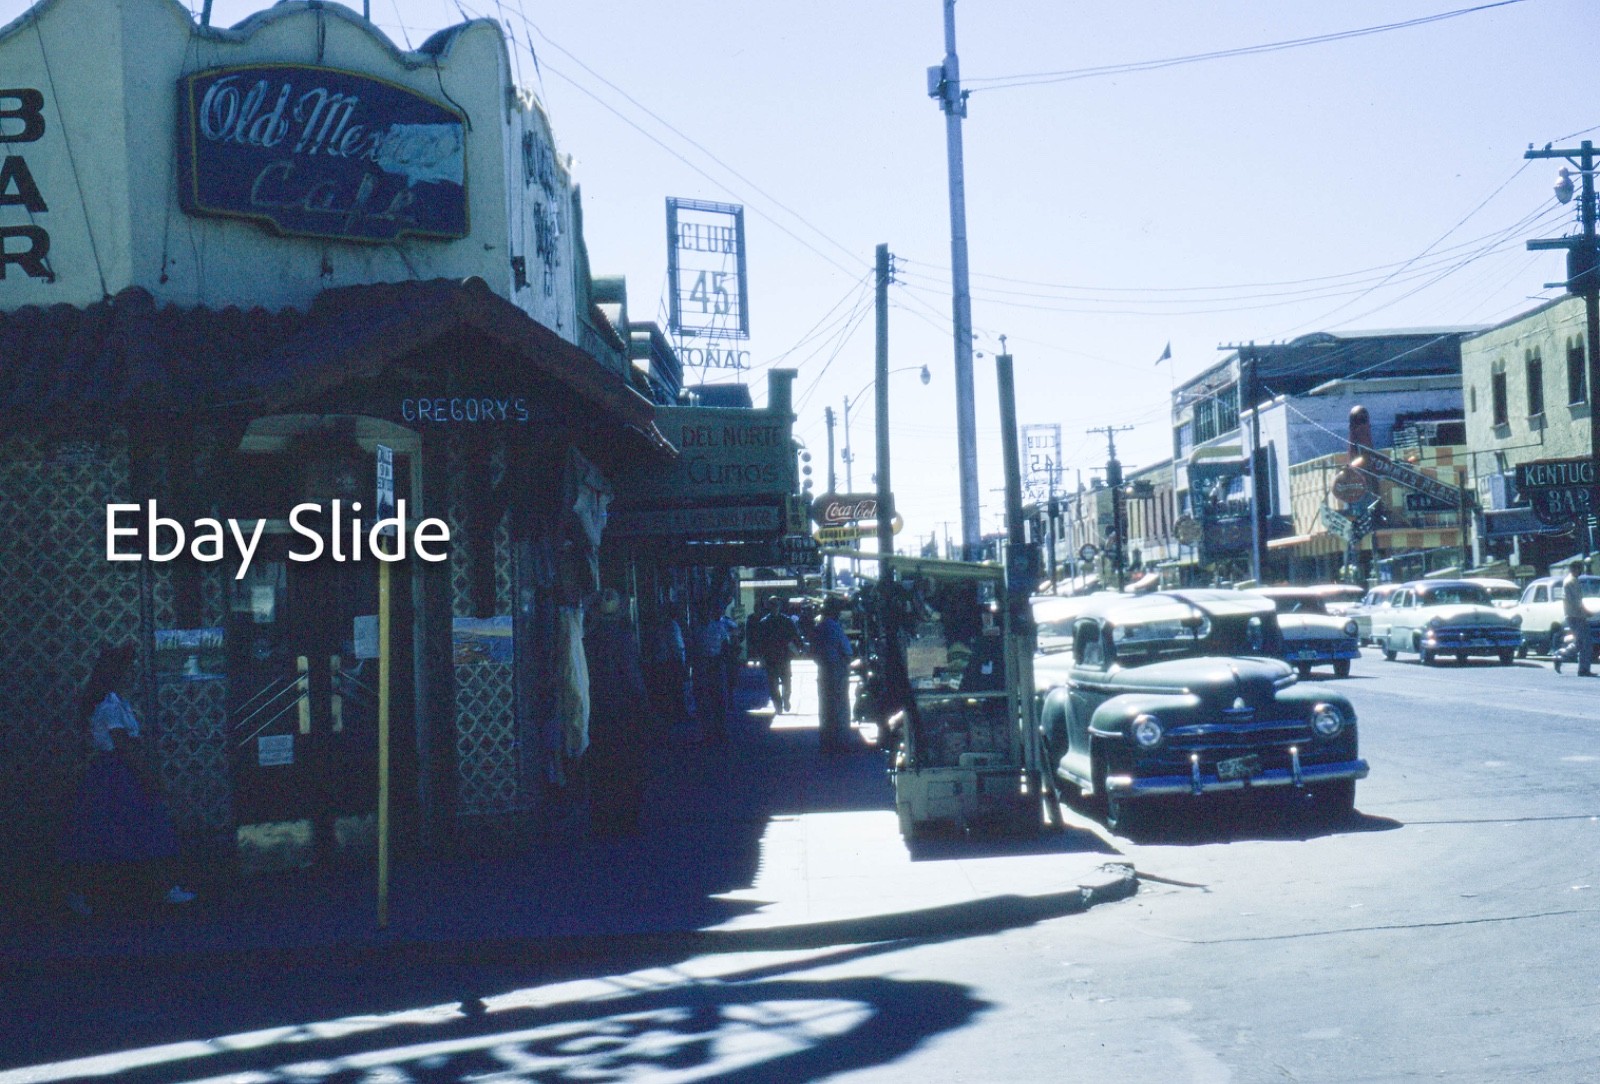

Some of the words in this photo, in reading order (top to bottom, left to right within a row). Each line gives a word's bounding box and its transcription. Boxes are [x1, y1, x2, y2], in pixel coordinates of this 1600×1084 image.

[200, 75, 291, 147] Old
[0, 88, 55, 280] BAR
[682, 222, 737, 253] CLUB
[689, 270, 730, 315] 45
[402, 397, 530, 423] GREGORY'S
[682, 425, 718, 447] DEL
[723, 424, 783, 446] NORTE
[687, 455, 779, 486] Curios
[1548, 488, 1590, 514] BAR
